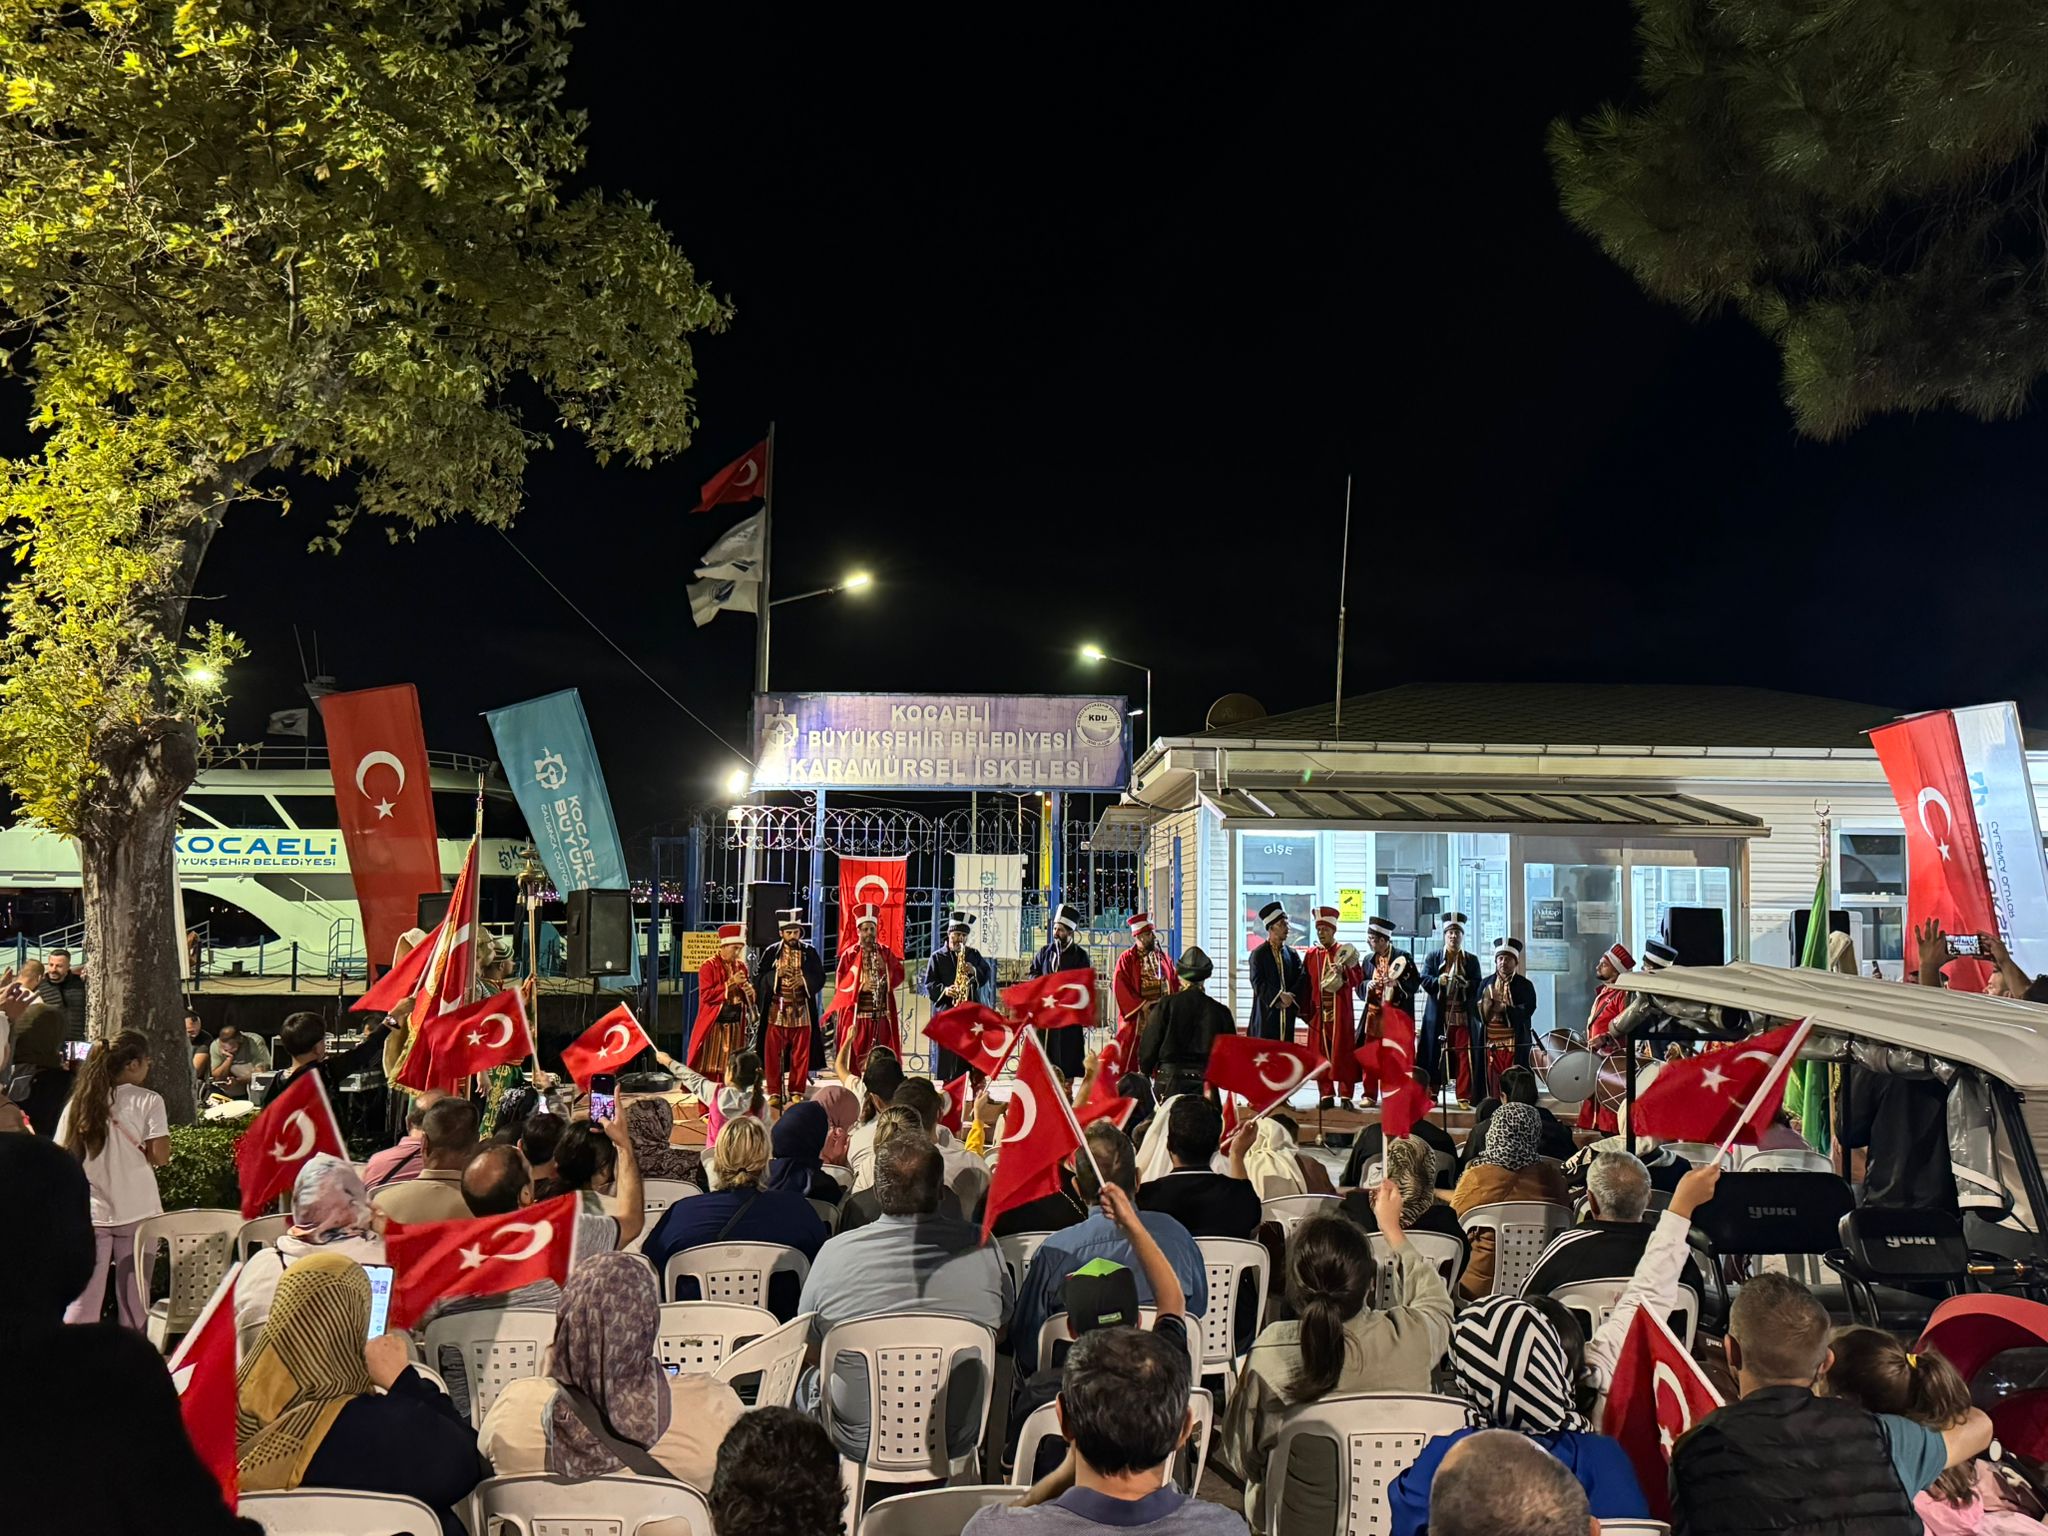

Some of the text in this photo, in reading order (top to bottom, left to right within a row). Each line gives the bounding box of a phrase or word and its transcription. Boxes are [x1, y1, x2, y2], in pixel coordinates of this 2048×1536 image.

[891, 701, 990, 722] KOCAELİ
[1088, 714, 1108, 722] KDU
[808, 727, 1072, 750] BÜYÜKŞEHİR BELEDİYESİ
[790, 755, 1089, 779] KARAMÜRSEL İSKELESİ
